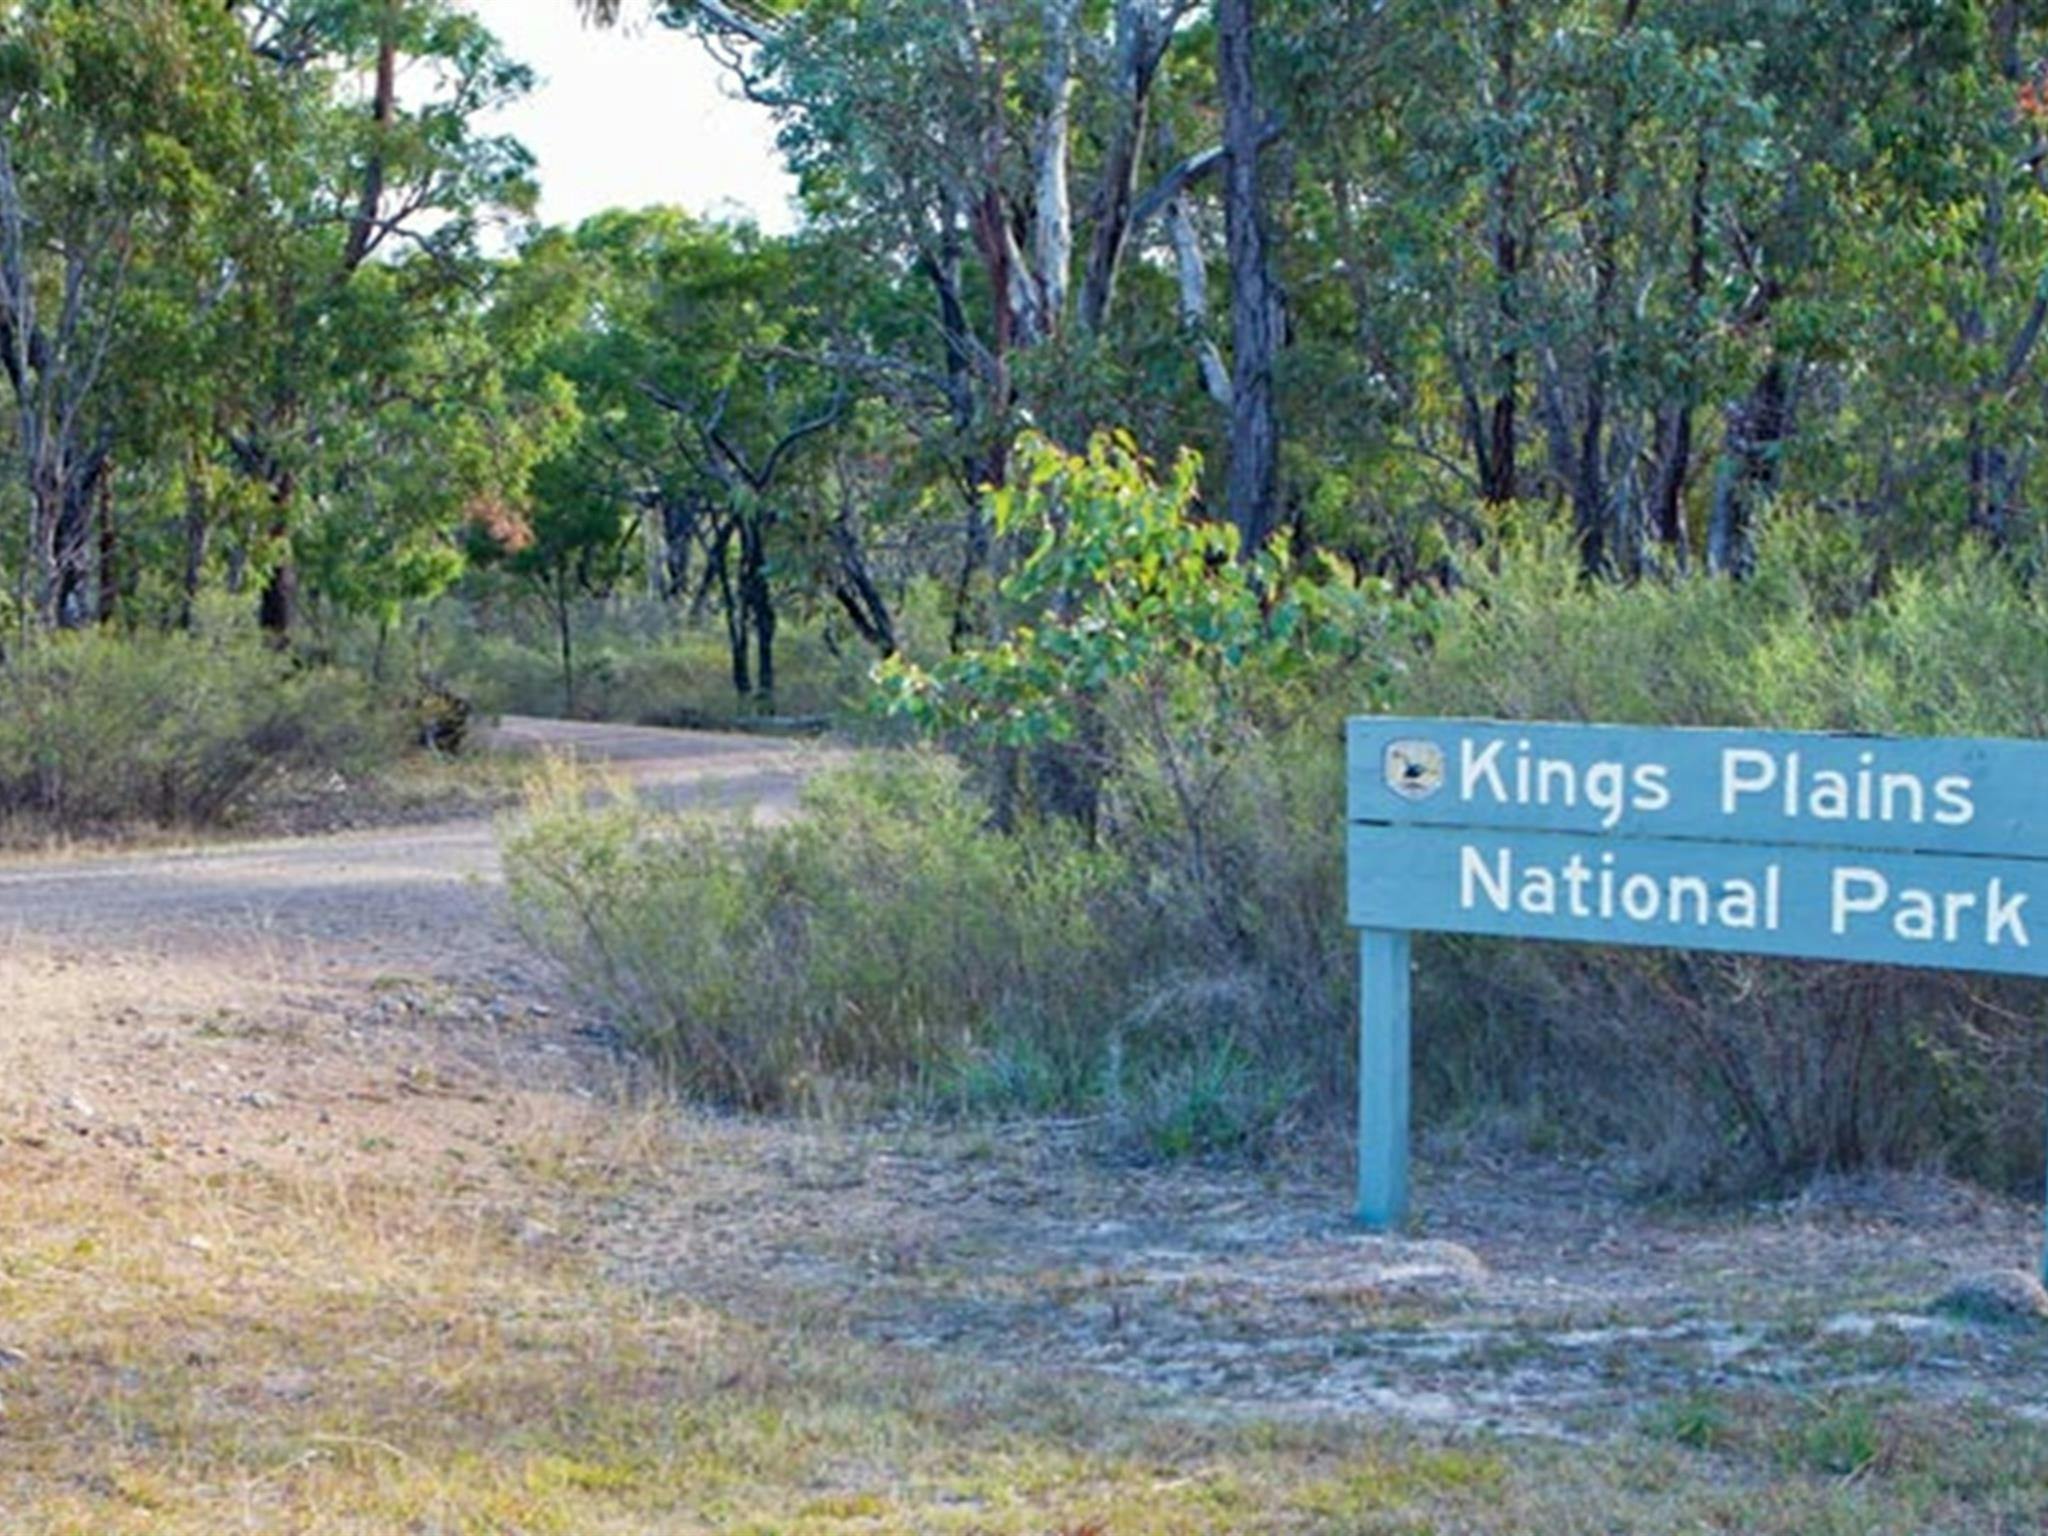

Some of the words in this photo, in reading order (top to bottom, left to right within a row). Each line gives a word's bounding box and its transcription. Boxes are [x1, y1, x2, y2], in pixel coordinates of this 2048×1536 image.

[1460, 738, 1670, 827] Kings
[1722, 748, 1973, 824] Plains
[1460, 845, 1779, 929] National
[1832, 867, 2029, 946] Park
